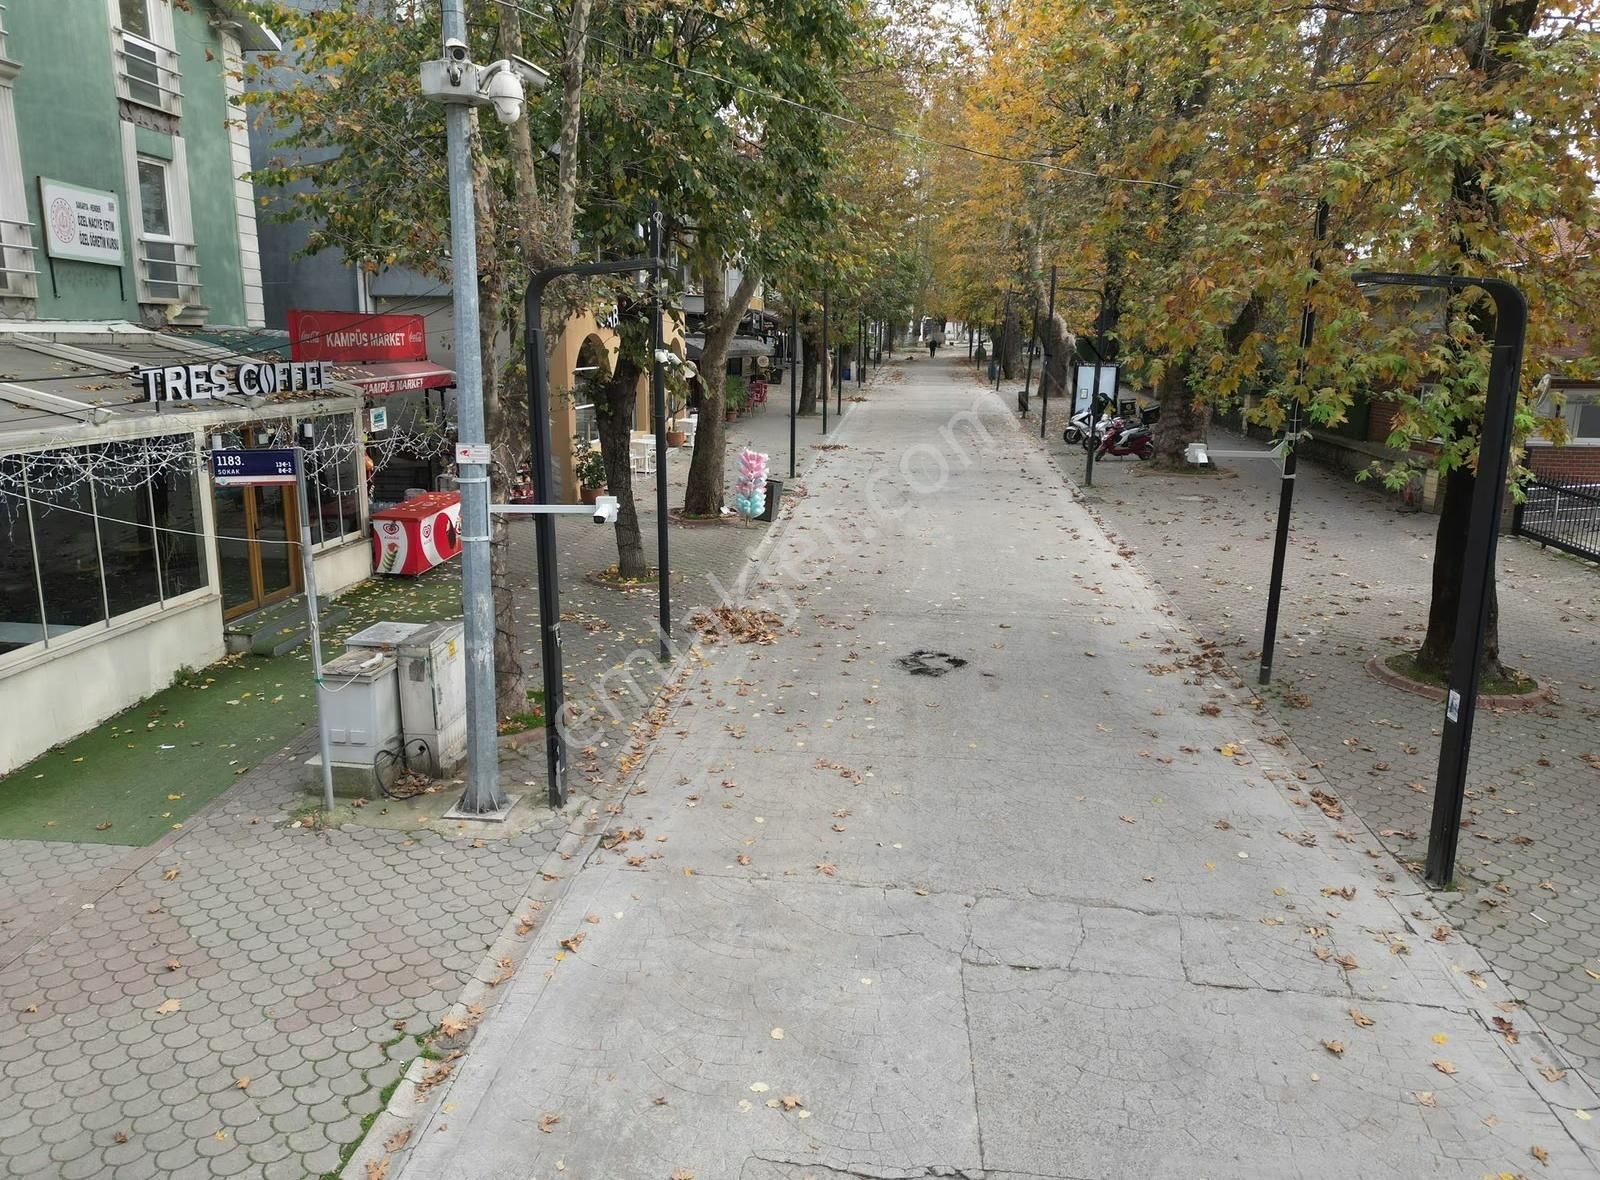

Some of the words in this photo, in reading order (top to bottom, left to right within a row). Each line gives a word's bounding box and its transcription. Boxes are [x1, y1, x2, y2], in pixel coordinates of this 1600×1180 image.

[325, 328, 369, 348] KAMPÜS
[369, 332, 406, 347] MARKET
[139, 364, 230, 402] TRES
[395, 378, 424, 392] MARKET
[216, 455, 245, 466] 1183.
